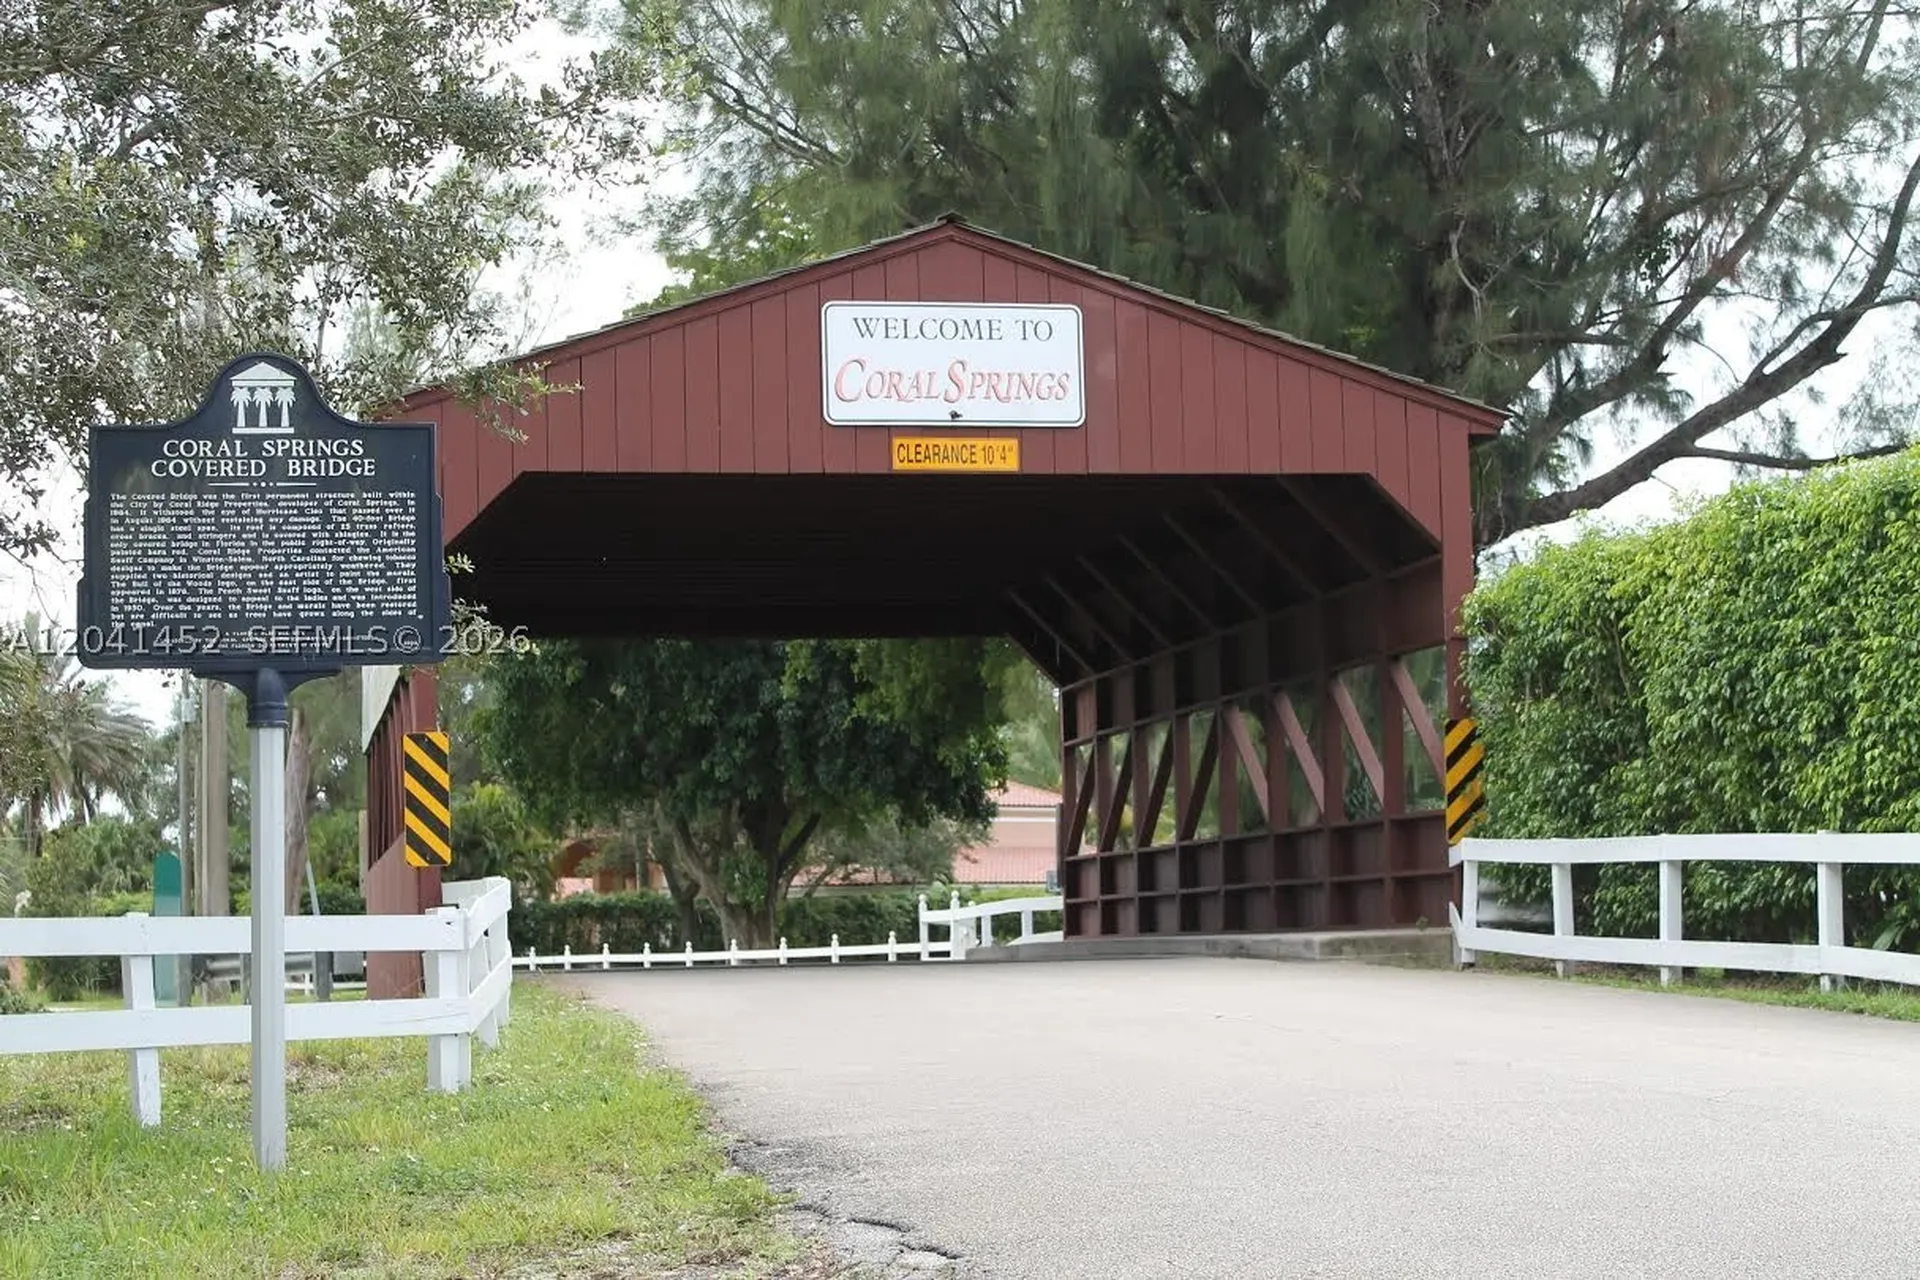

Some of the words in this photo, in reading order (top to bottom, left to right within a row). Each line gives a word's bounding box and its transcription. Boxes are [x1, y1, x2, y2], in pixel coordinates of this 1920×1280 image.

[853, 317, 1003, 341] WELCOME
[1014, 319, 1053, 341] TO
[163, 439, 248, 457] CORAL
[262, 438, 364, 457] SPRINGS
[897, 443, 978, 464] CLEARANCE
[151, 459, 266, 477] COVERED
[288, 458, 376, 477] BRIDGE
[170, 493, 198, 501] Bridge
[265, 492, 309, 500] permanent
[196, 501, 220, 509] Ridge
[277, 500, 318, 508] developer
[352, 507, 380, 515] passed
[388, 514, 416, 522] Bridge
[198, 532, 237, 540] stringers
[110, 541, 128, 549] only
[281, 539, 306, 547] public
[372, 538, 416, 546] Originally
[257, 547, 302, 555] Properties
[137, 556, 174, 564] Company
[348, 554, 382, 562] chewing
[110, 565, 143, 573] designs
[206, 564, 234, 572] Bridge
[274, 563, 333, 571] appropriately
[395, 562, 416, 570] They
[339, 570, 361, 578] paint
[110, 588, 151, 596] appeared
[186, 595, 223, 603] designed
[241, 595, 269, 603] appeal
[246, 603, 273, 611] Bridge
[331, 610, 355, 618] along
